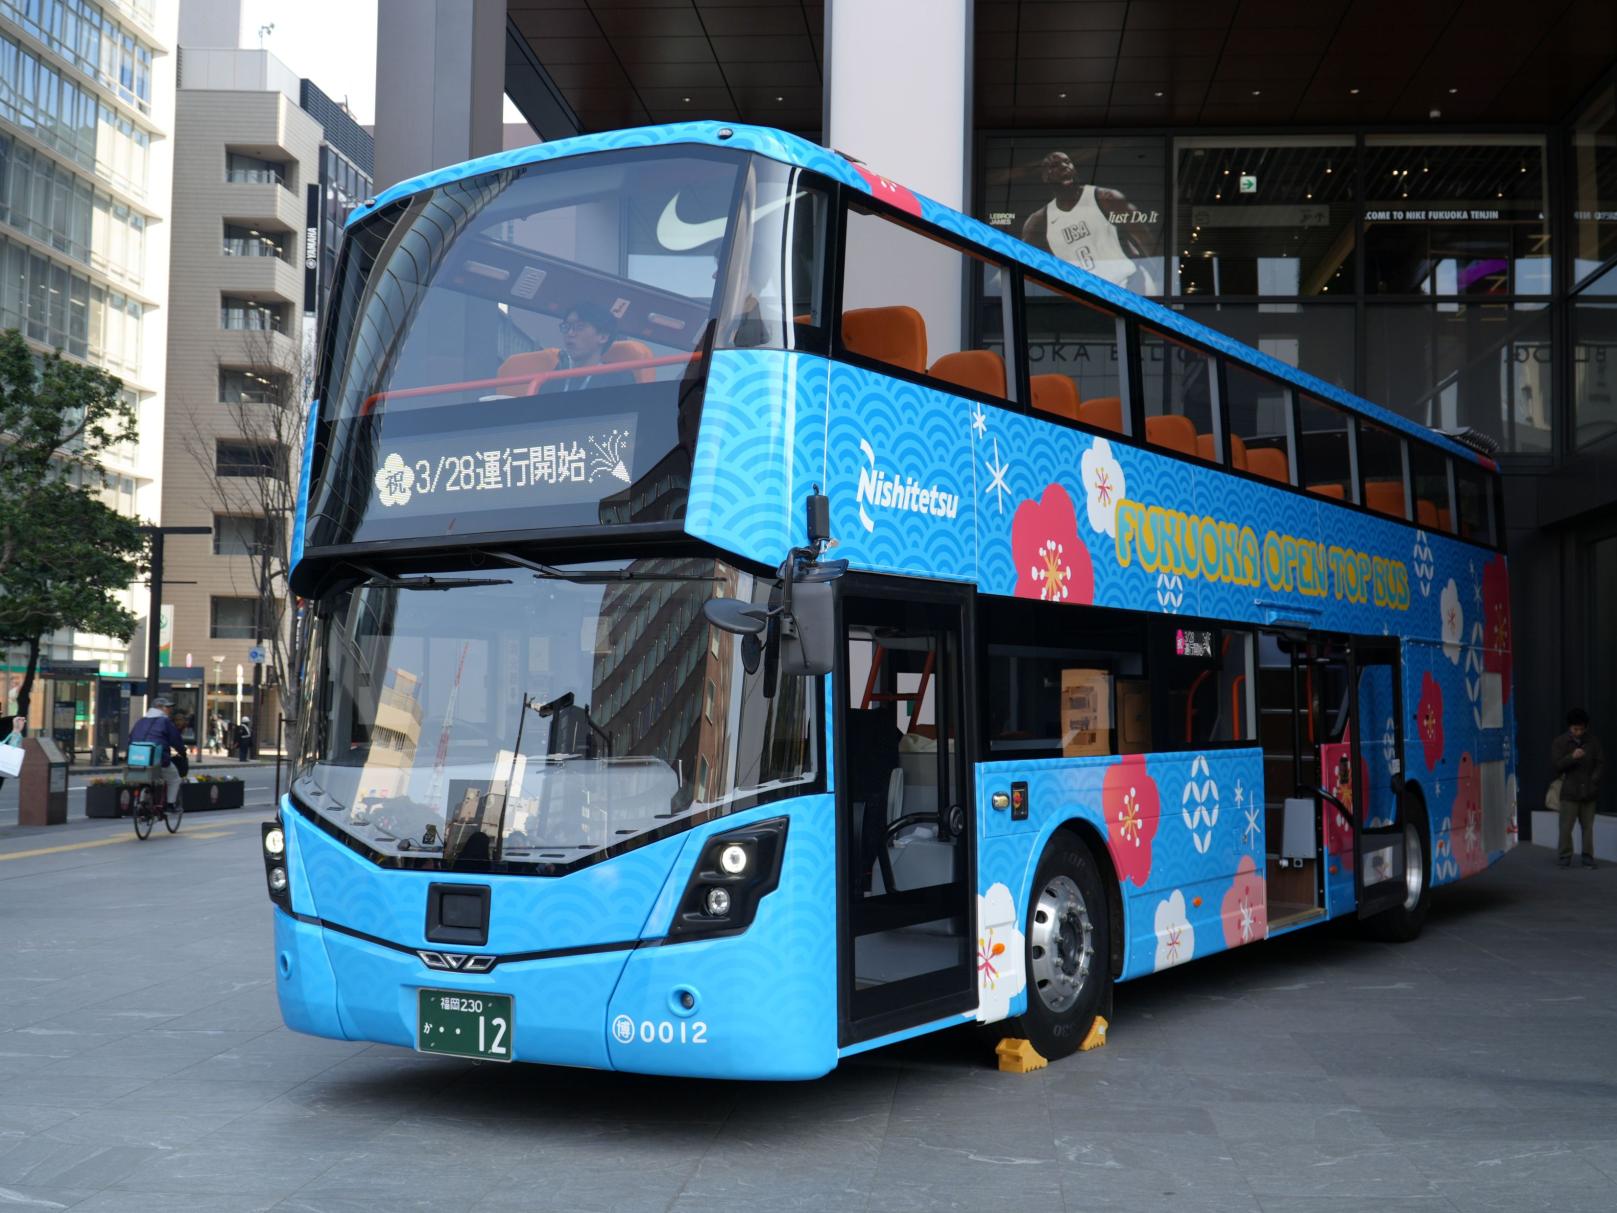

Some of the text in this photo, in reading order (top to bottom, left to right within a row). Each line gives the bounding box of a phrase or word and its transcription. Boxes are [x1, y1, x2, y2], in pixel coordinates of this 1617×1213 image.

[1108, 211, 1130, 224] Just
[1130, 210, 1148, 224] Do
[1365, 210, 1499, 220] COME TO NIKE FUKUOKA TENJIN
[306, 227, 317, 259] YAMAHA
[1062, 220, 1091, 245] USA
[1025, 343, 1090, 362] OKA
[415, 441, 587, 494] 3/28運行開始
[856, 466, 959, 519] Nishitetsu
[1115, 498, 1410, 611] FUKUOKA OPEN TOP BUS
[440, 997, 483, 1013] 福岡230
[423, 1022, 433, 1034] か
[640, 1020, 708, 1044] 0012
